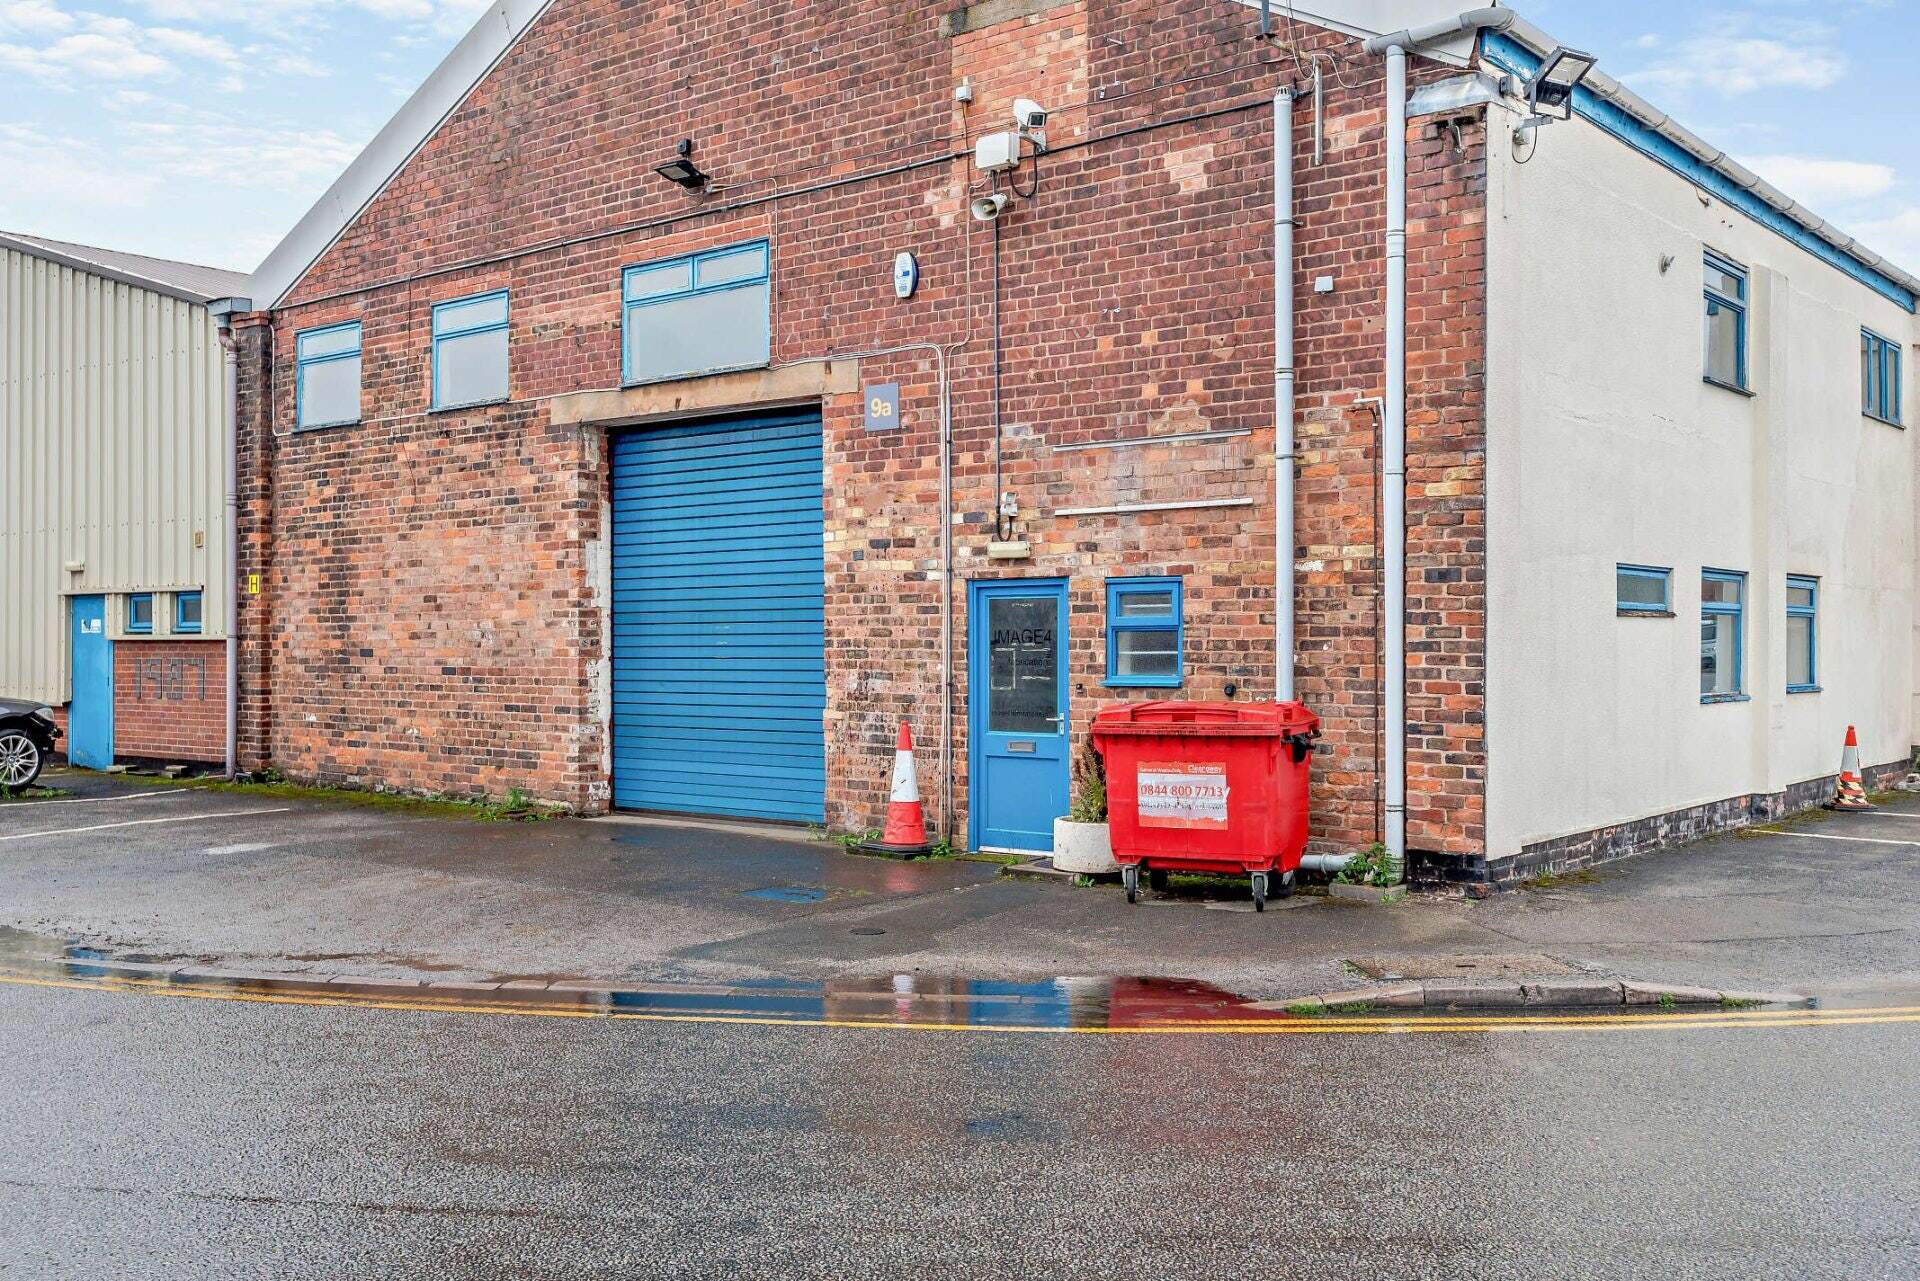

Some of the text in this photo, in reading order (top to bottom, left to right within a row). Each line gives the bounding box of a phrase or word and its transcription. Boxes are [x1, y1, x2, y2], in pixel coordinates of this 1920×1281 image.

[870, 397, 892, 418] 9a
[994, 628, 1052, 645] IMAGE4
[134, 657, 206, 702] 1987
[1140, 784, 1224, 798] 0844 800 7713
